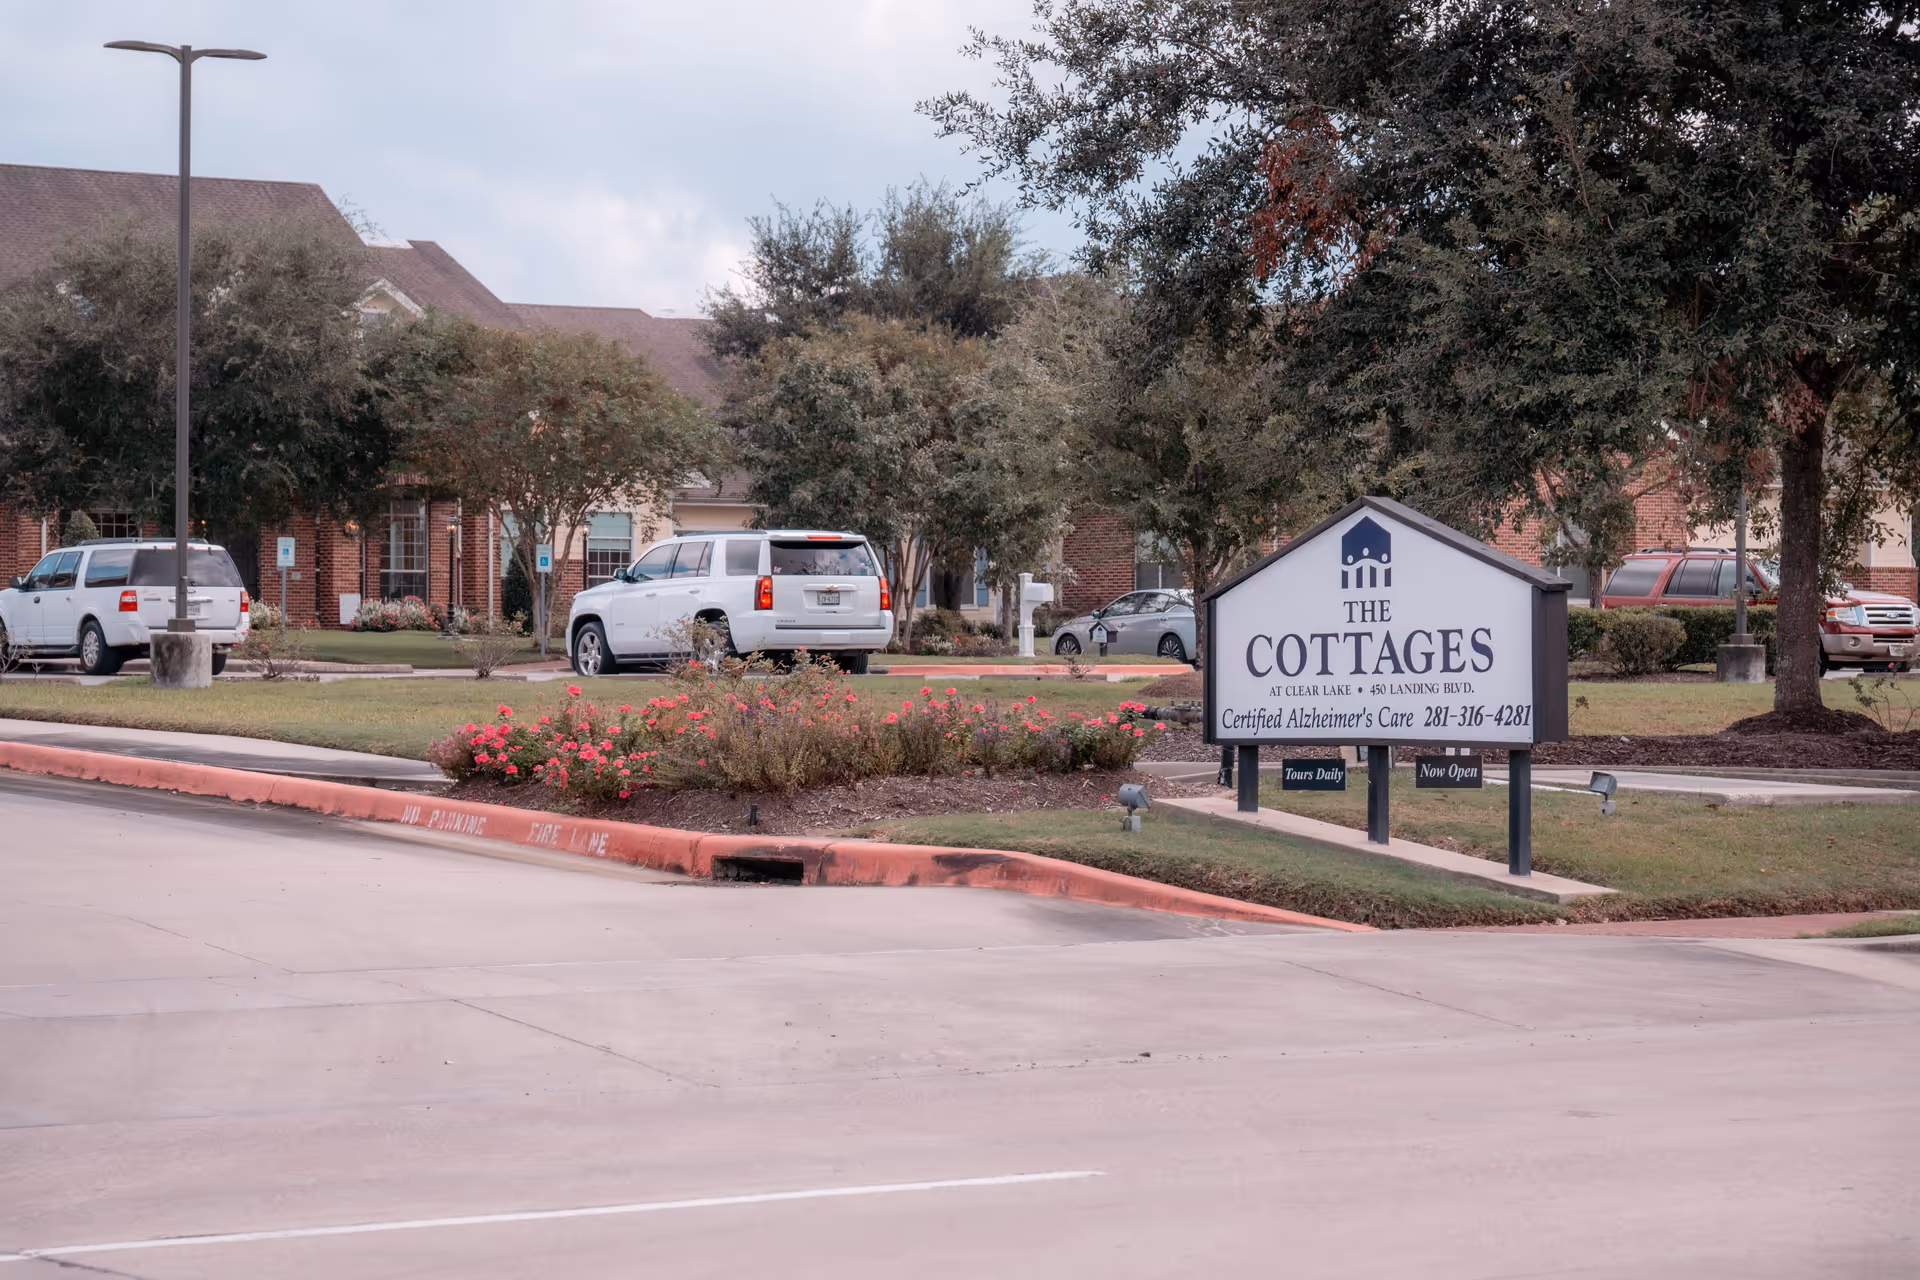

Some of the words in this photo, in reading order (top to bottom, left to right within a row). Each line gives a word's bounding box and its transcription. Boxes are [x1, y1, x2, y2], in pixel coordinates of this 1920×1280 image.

[1343, 599, 1392, 624] THE
[1245, 627, 1494, 678] COTTAGES
[1269, 685, 1282, 697] AT
[1285, 685, 1320, 697] CLEAR
[1323, 684, 1352, 696] LAKE
[1369, 683, 1387, 696] 450
[1390, 682, 1440, 695] LANDING
[1443, 682, 1475, 694] BLVD.
[1222, 707, 1283, 736] Certified
[1285, 706, 1373, 729] Alzheimer's
[1378, 706, 1414, 728] Care
[1423, 704, 1532, 727] 281-316-4281
[1285, 767, 1314, 780] Tours
[1315, 767, 1344, 783] Daily
[1420, 763, 1445, 778] Now
[1448, 763, 1478, 782] Open
[401, 804, 421, 825] NO
[427, 808, 488, 836] PARKING
[526, 821, 562, 845] FIRE
